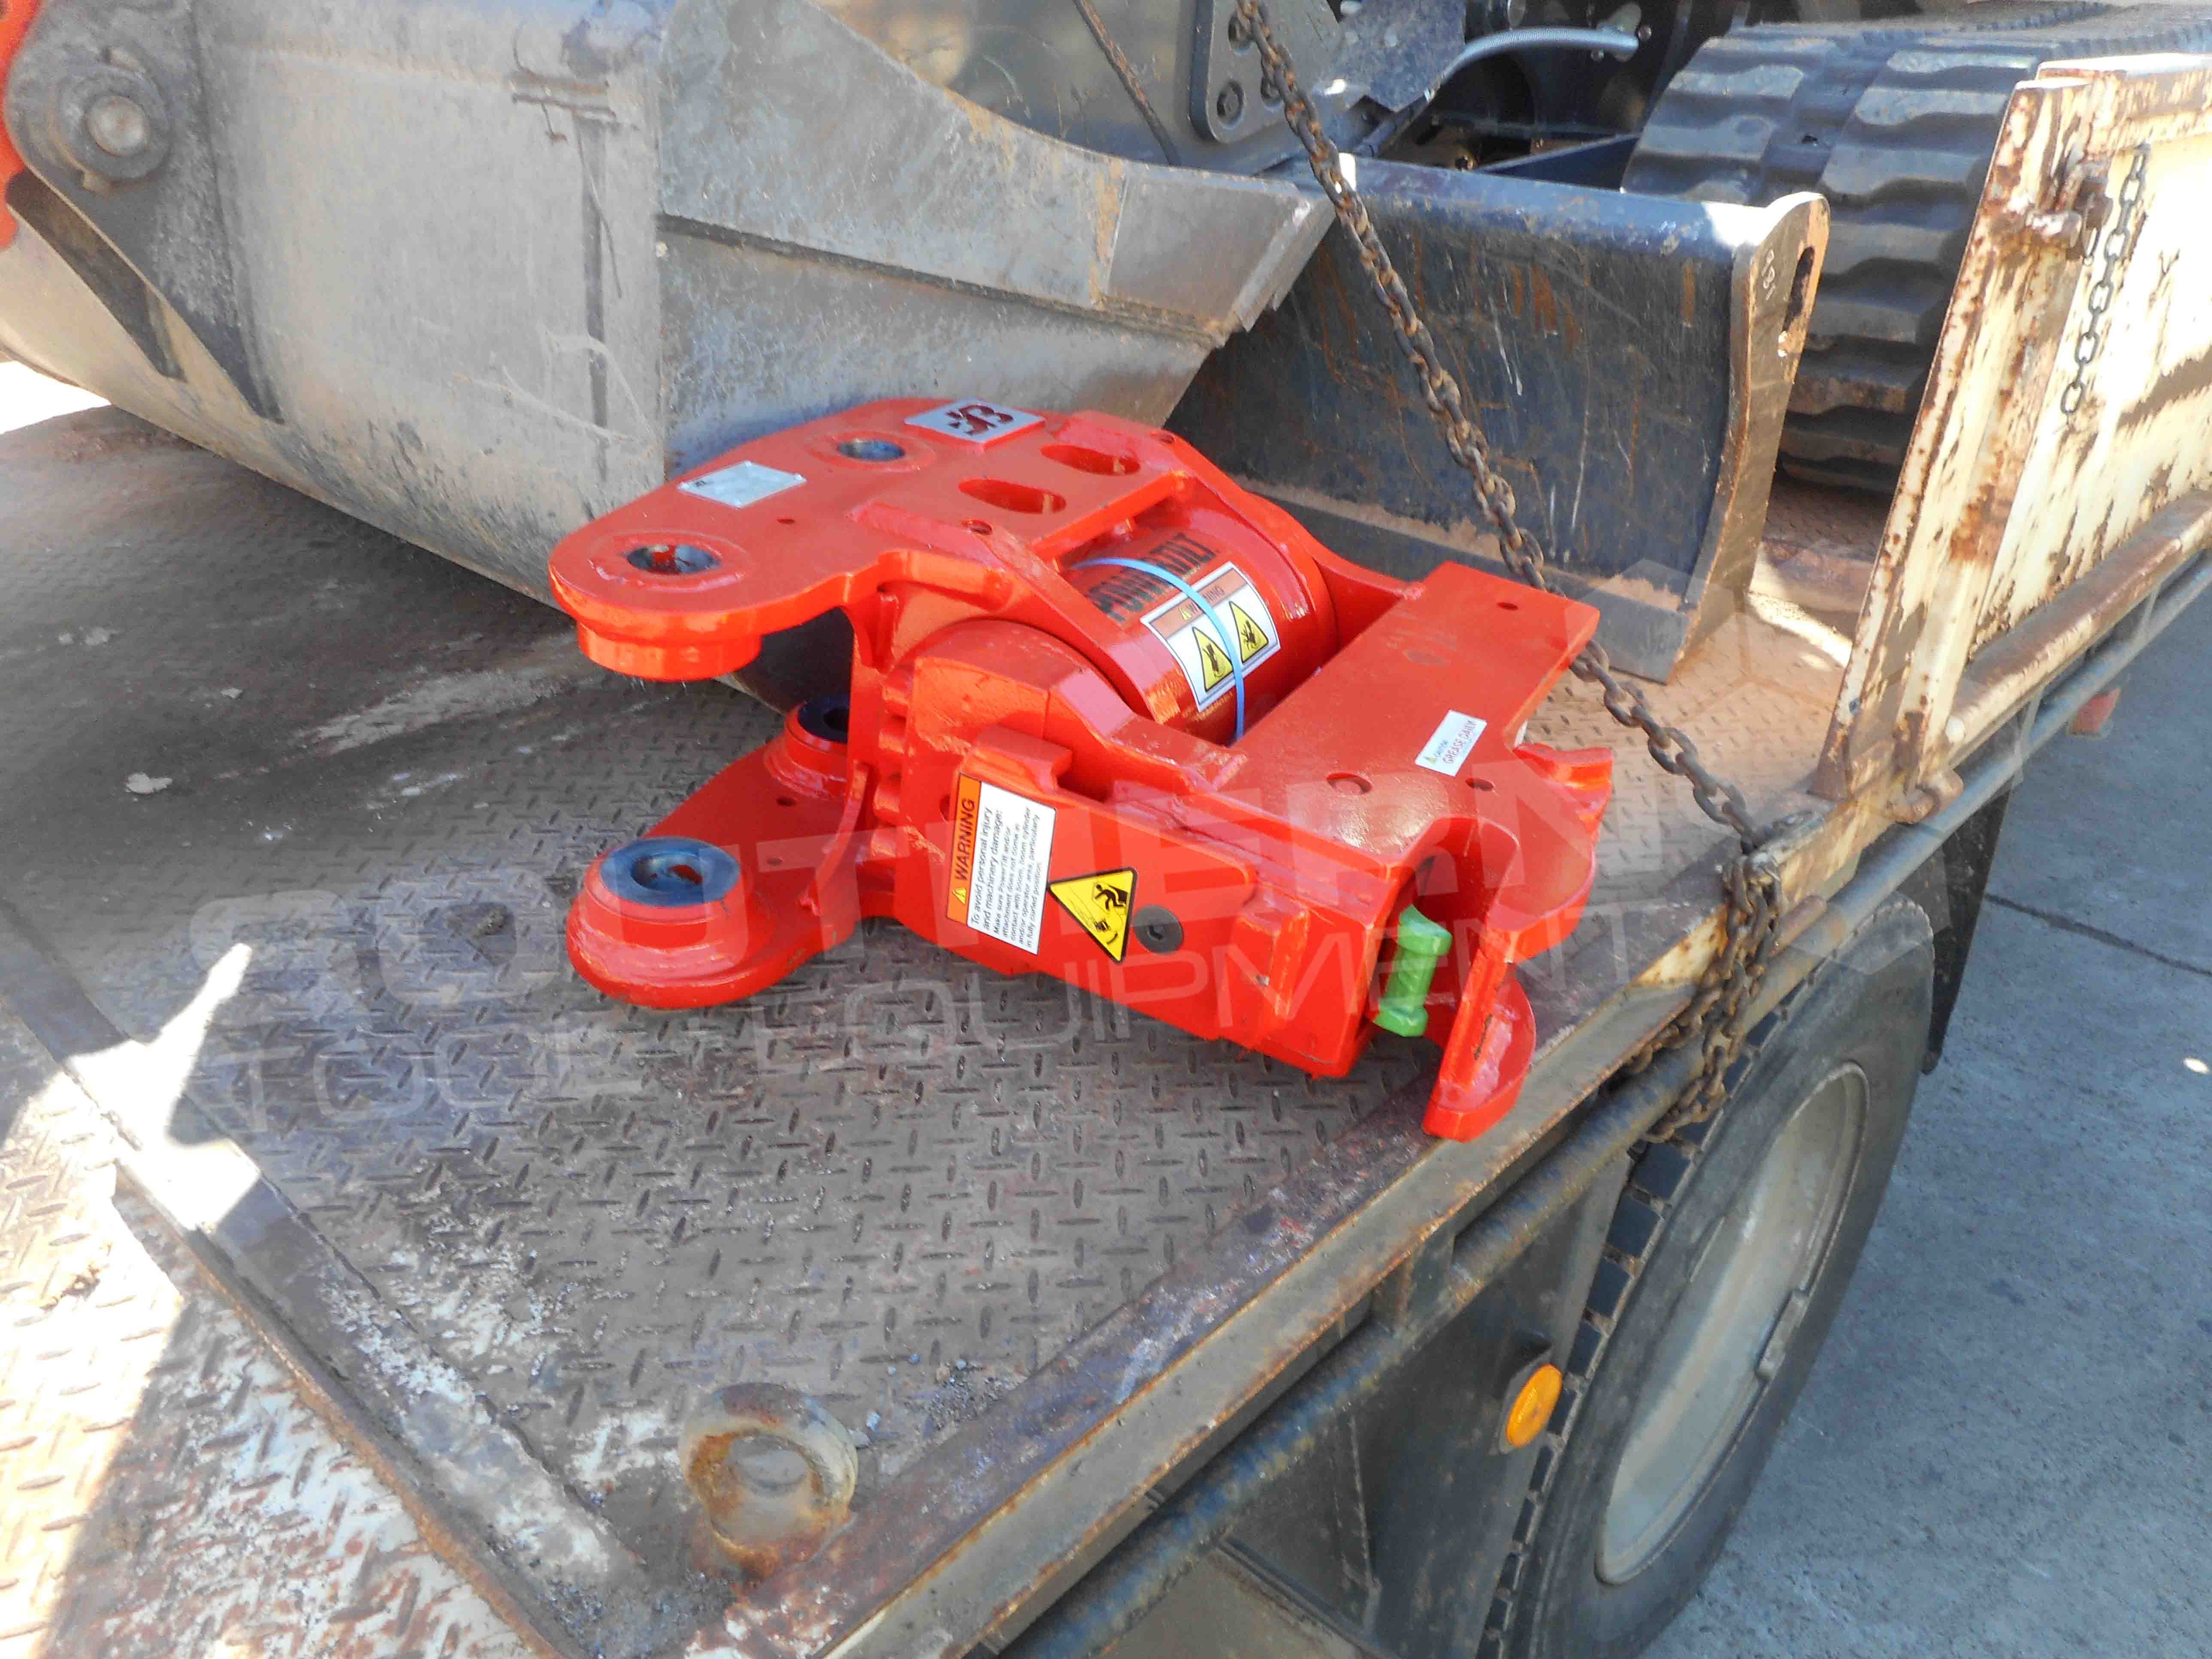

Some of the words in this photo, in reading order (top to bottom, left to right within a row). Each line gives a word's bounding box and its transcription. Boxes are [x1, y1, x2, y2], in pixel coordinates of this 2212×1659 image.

[981, 807, 992, 838] injury
[990, 809, 1003, 856] damage:
[1028, 814, 1040, 861] particularly
[955, 798, 975, 881] WARNING
[1003, 826, 1011, 854] and/or
[976, 838, 990, 884] personal
[1010, 911, 1018, 941] contact
[1022, 807, 1032, 840] cylinder
[984, 855, 998, 910] machinery
[1002, 893, 1012, 938] attachment
[1014, 823, 1020, 832] in
[973, 884, 983, 912] avoid
[1021, 883, 1031, 918] operator
[1029, 895, 1037, 922] curled
[971, 912, 980, 925] To
[982, 910, 991, 930] and
[1018, 918, 1026, 945] and/or
[1027, 921, 1035, 939] fully
[1026, 939, 1031, 948] in
